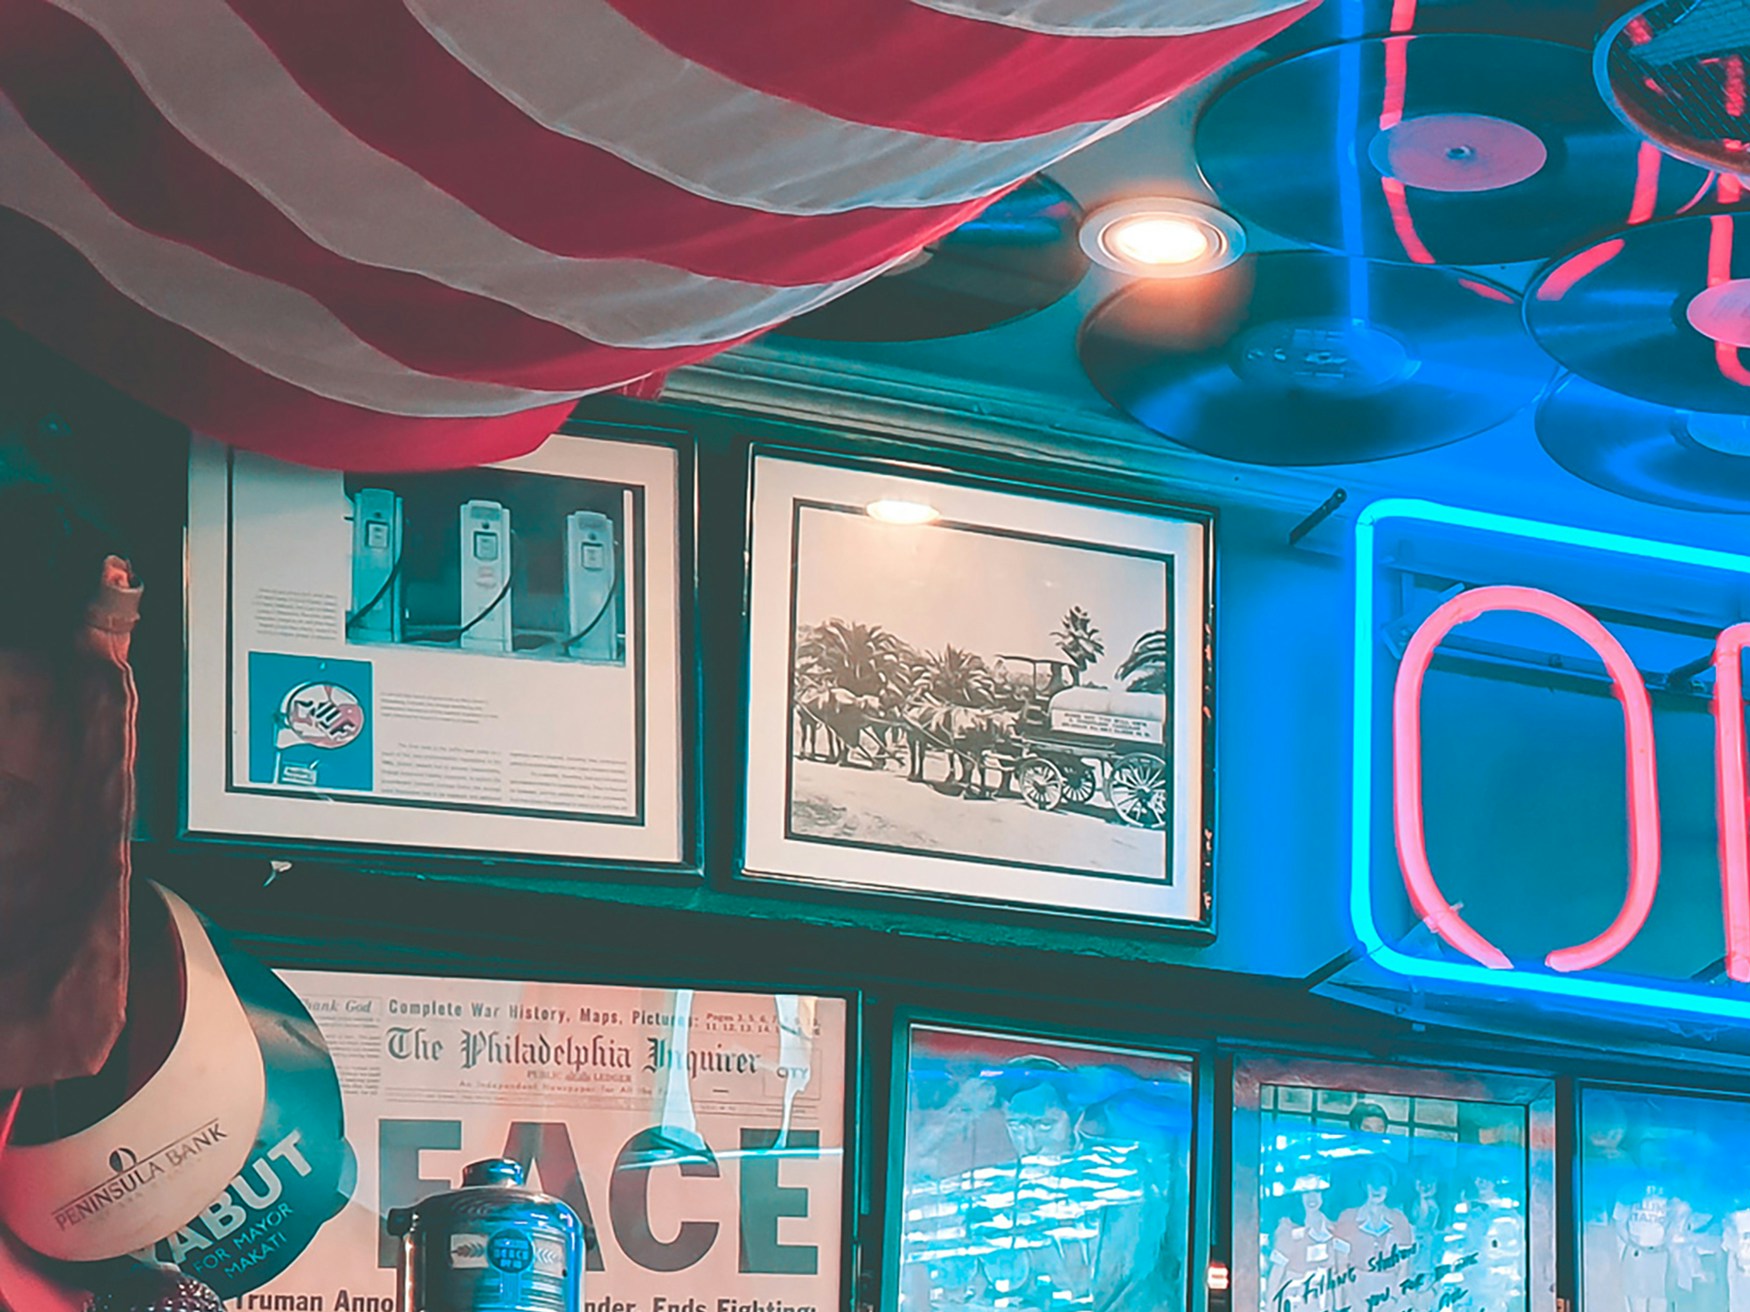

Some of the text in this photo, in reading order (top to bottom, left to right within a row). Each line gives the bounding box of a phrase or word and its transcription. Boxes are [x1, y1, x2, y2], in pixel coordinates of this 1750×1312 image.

[345, 999, 373, 1014] God
[388, 998, 463, 1019] Complete
[471, 1001, 500, 1019] War
[509, 1003, 571, 1024] History,
[580, 1007, 623, 1025] Maps,
[386, 1027, 444, 1061] The
[460, 1029, 632, 1072] Philadelphia
[642, 1037, 763, 1079] Inquirer
[54, 1122, 228, 1232] PENINSULA BANK
[192, 1202, 294, 1274] FOR MAYOR
[223, 1230, 288, 1280] MAKATI
[235, 1292, 323, 1312] Truman
[334, 1290, 394, 1312] Anno
